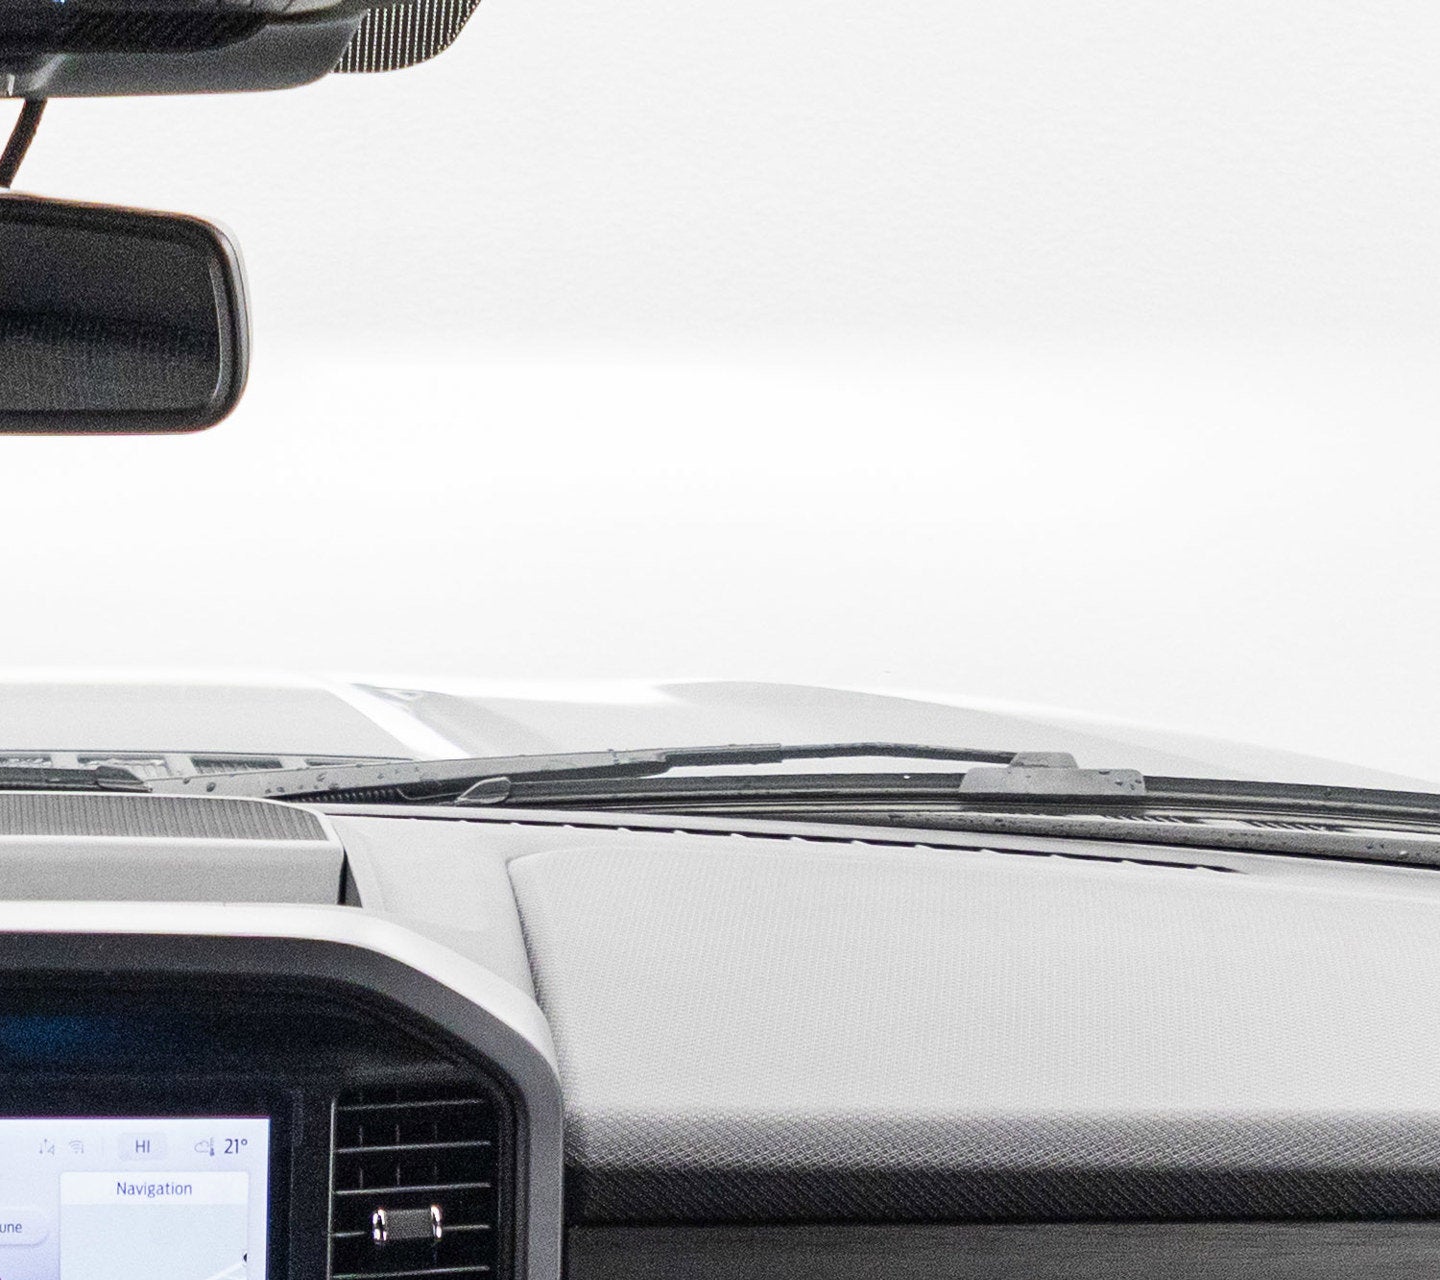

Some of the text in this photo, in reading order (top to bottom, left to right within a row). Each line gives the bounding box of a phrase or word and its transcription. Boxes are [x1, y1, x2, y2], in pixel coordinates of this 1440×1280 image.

[135, 1140, 151, 1153] HI
[224, 1138, 248, 1154] 21°
[116, 1181, 193, 1199] Navigation
